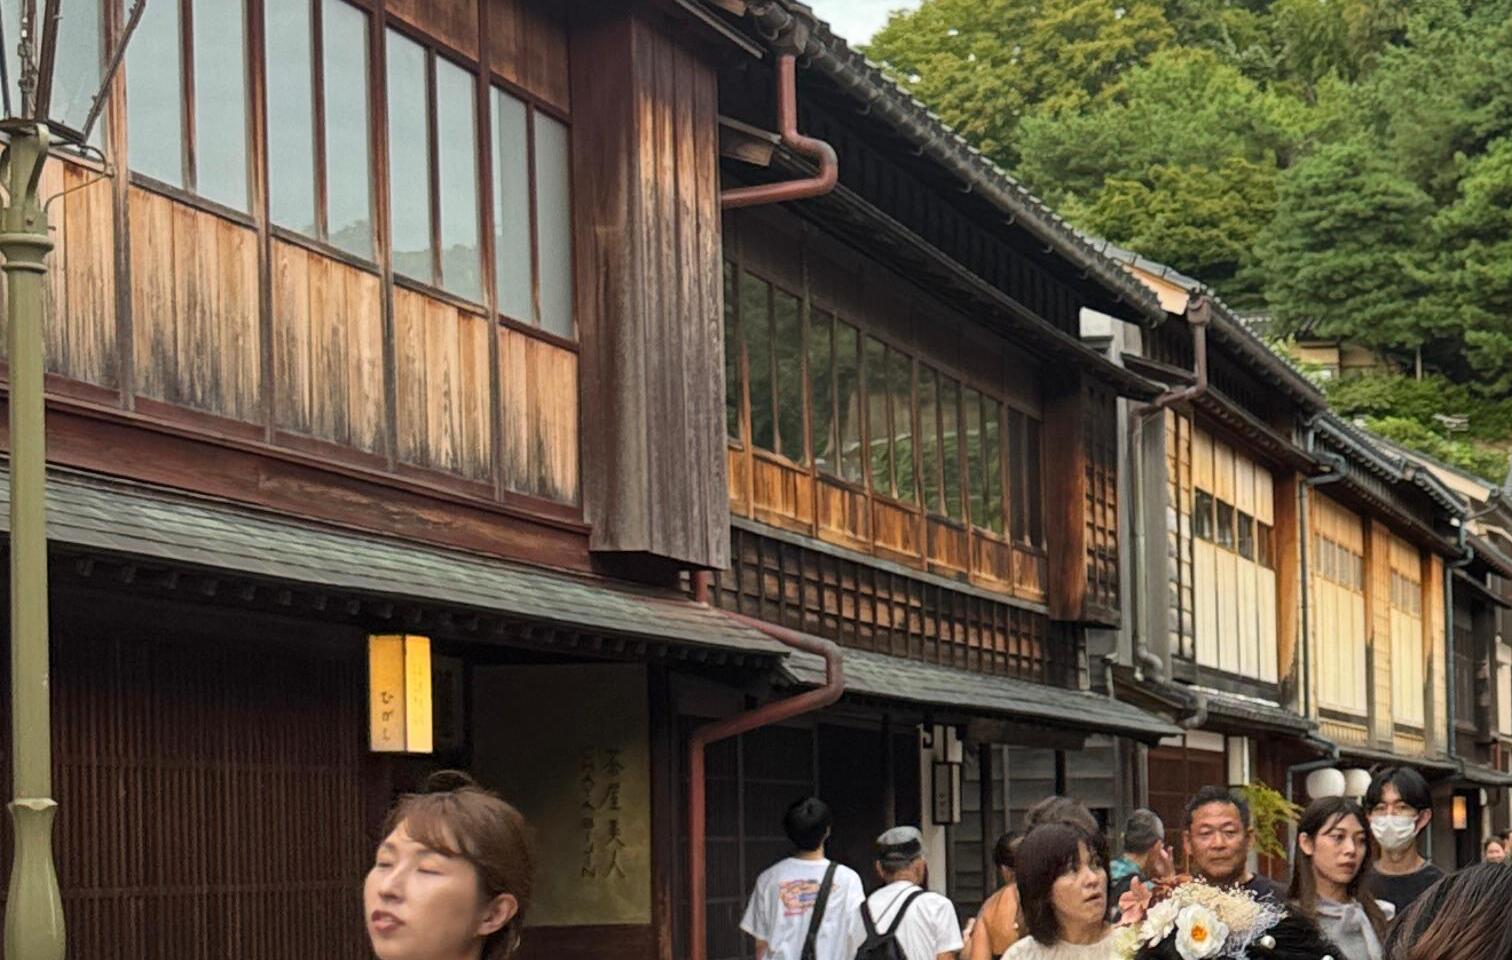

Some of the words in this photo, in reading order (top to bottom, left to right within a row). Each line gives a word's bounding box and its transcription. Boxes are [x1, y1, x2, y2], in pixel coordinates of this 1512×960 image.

[381, 690, 395, 741] ひがし
[601, 749, 626, 878] 茶屋美人
